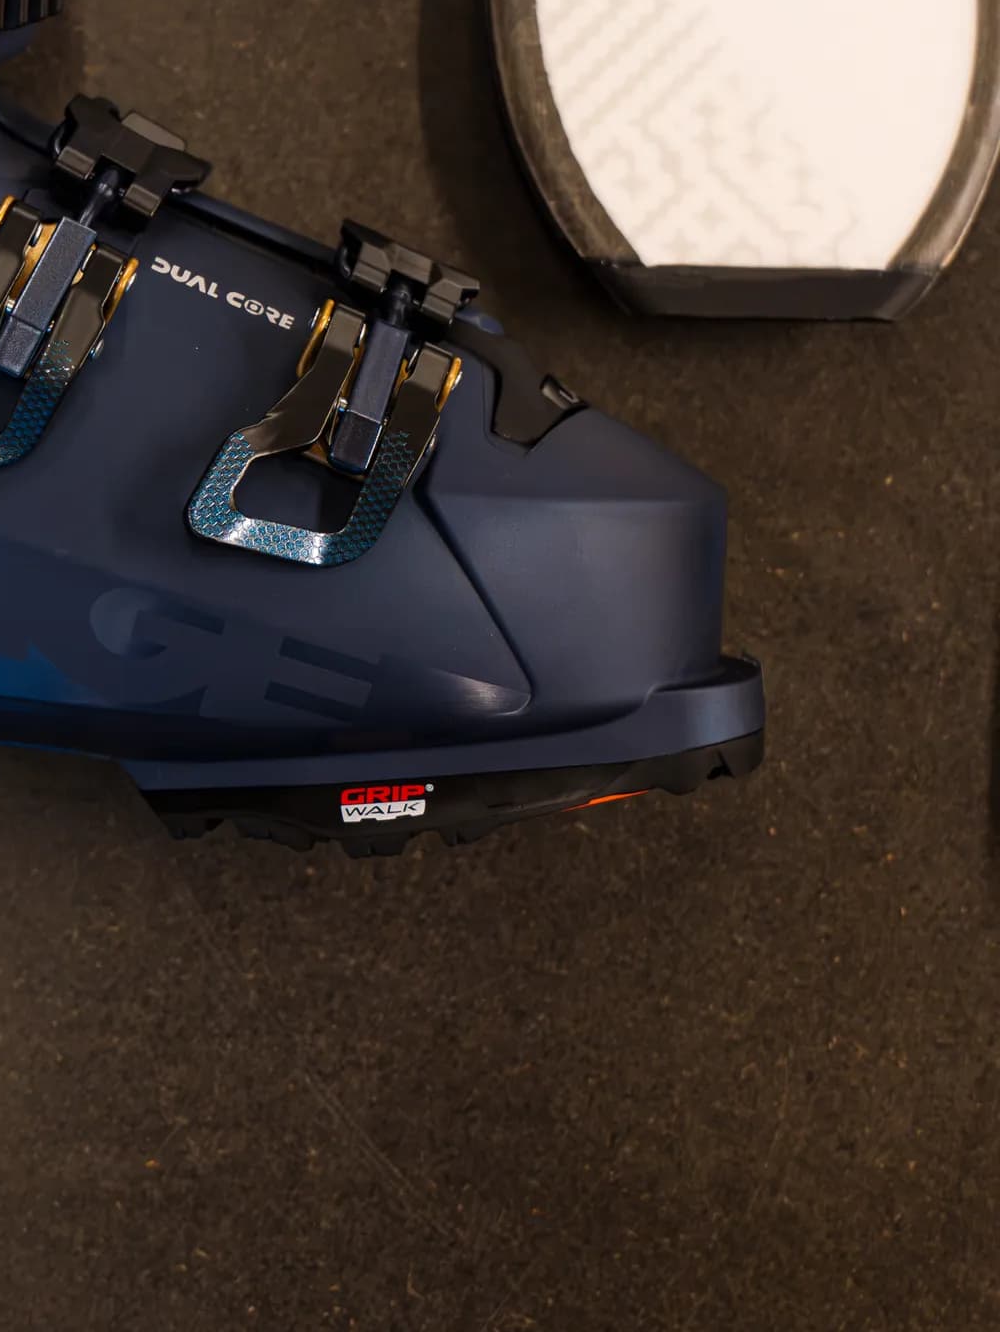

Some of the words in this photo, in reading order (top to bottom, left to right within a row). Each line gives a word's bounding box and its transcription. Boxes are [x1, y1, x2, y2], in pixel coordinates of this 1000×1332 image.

[151, 256, 218, 298] DUAL
[226, 291, 295, 330] CORE
[345, 802, 420, 817] WALK
